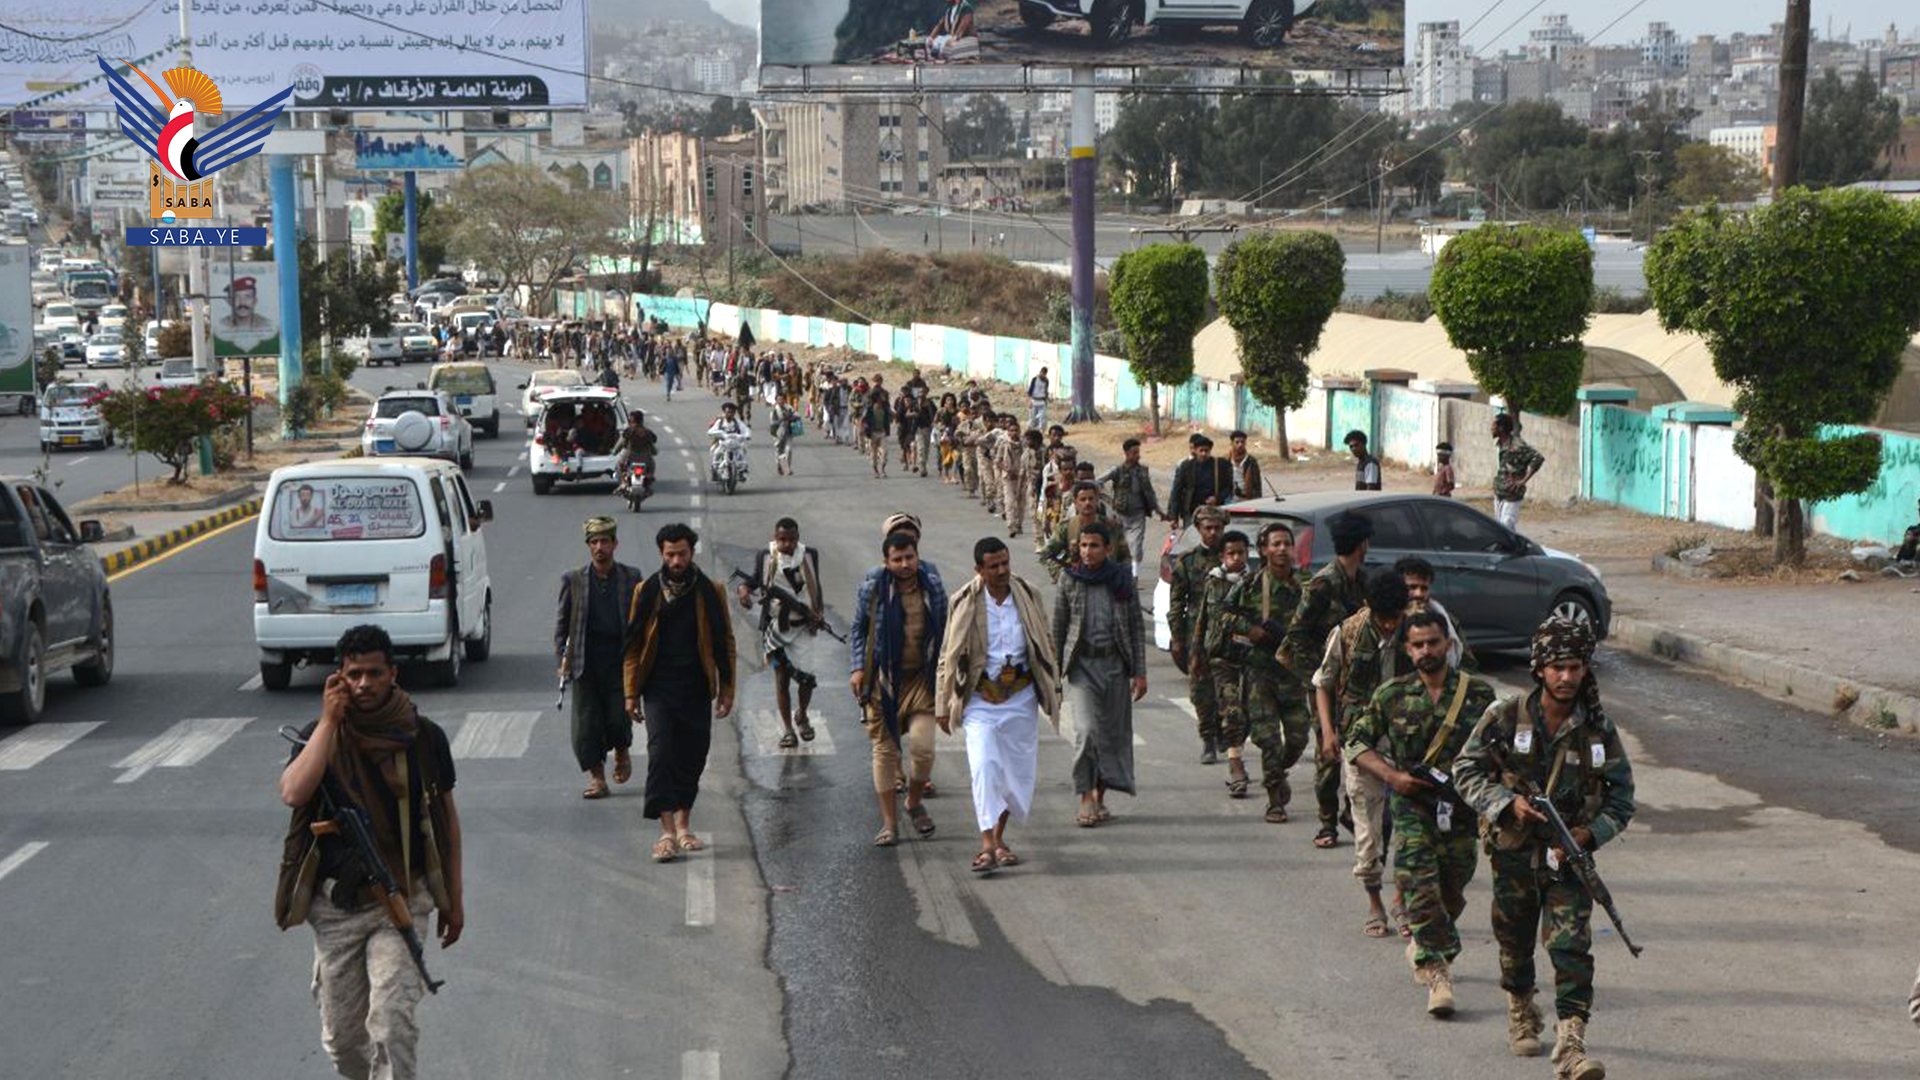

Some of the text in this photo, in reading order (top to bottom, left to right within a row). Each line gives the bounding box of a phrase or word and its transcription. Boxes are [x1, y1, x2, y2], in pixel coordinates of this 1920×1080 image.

[222, 3, 242, 15] من
[376, 3, 402, 18] وعي
[500, 3, 519, 15] من
[195, 31, 218, 48] ألف
[220, 37, 239, 51] من
[242, 31, 265, 51] أكثر
[267, 33, 289, 51] قبل
[292, 33, 333, 51] يلومهم
[337, 37, 356, 51] من
[359, 34, 394, 50] نفسية
[398, 36, 433, 51] يعيش
[484, 34, 494, 47] لا
[497, 38, 516, 50] من
[555, 33, 564, 46] لا
[331, 83, 351, 102] إب
[378, 80, 436, 101] للأوقاف
[441, 81, 486, 98] العامة
[491, 81, 532, 101] الهيئة
